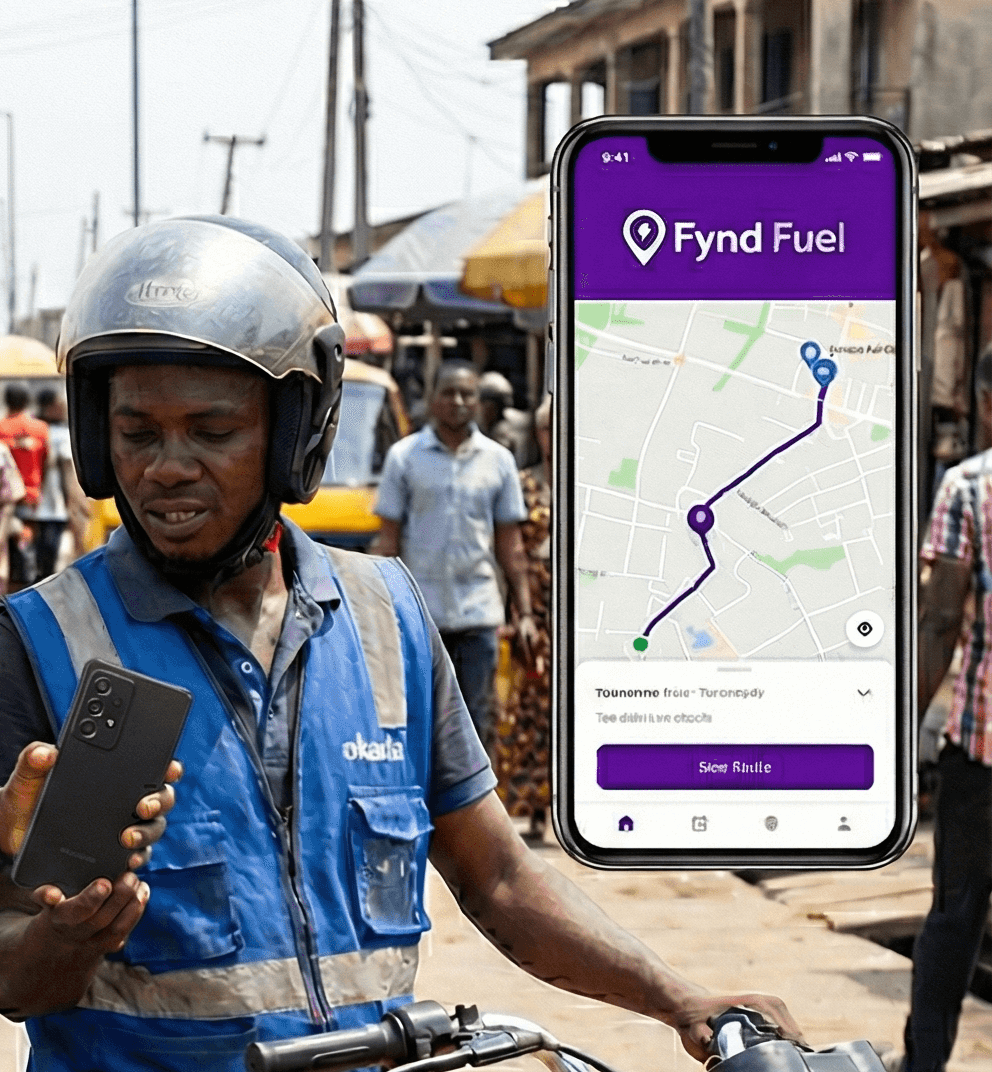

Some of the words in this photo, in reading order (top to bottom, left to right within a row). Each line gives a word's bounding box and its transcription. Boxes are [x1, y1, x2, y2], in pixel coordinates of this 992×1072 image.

[601, 151, 629, 164] 9:41
[674, 221, 762, 262] Fynd
[773, 221, 845, 253] Fuel
